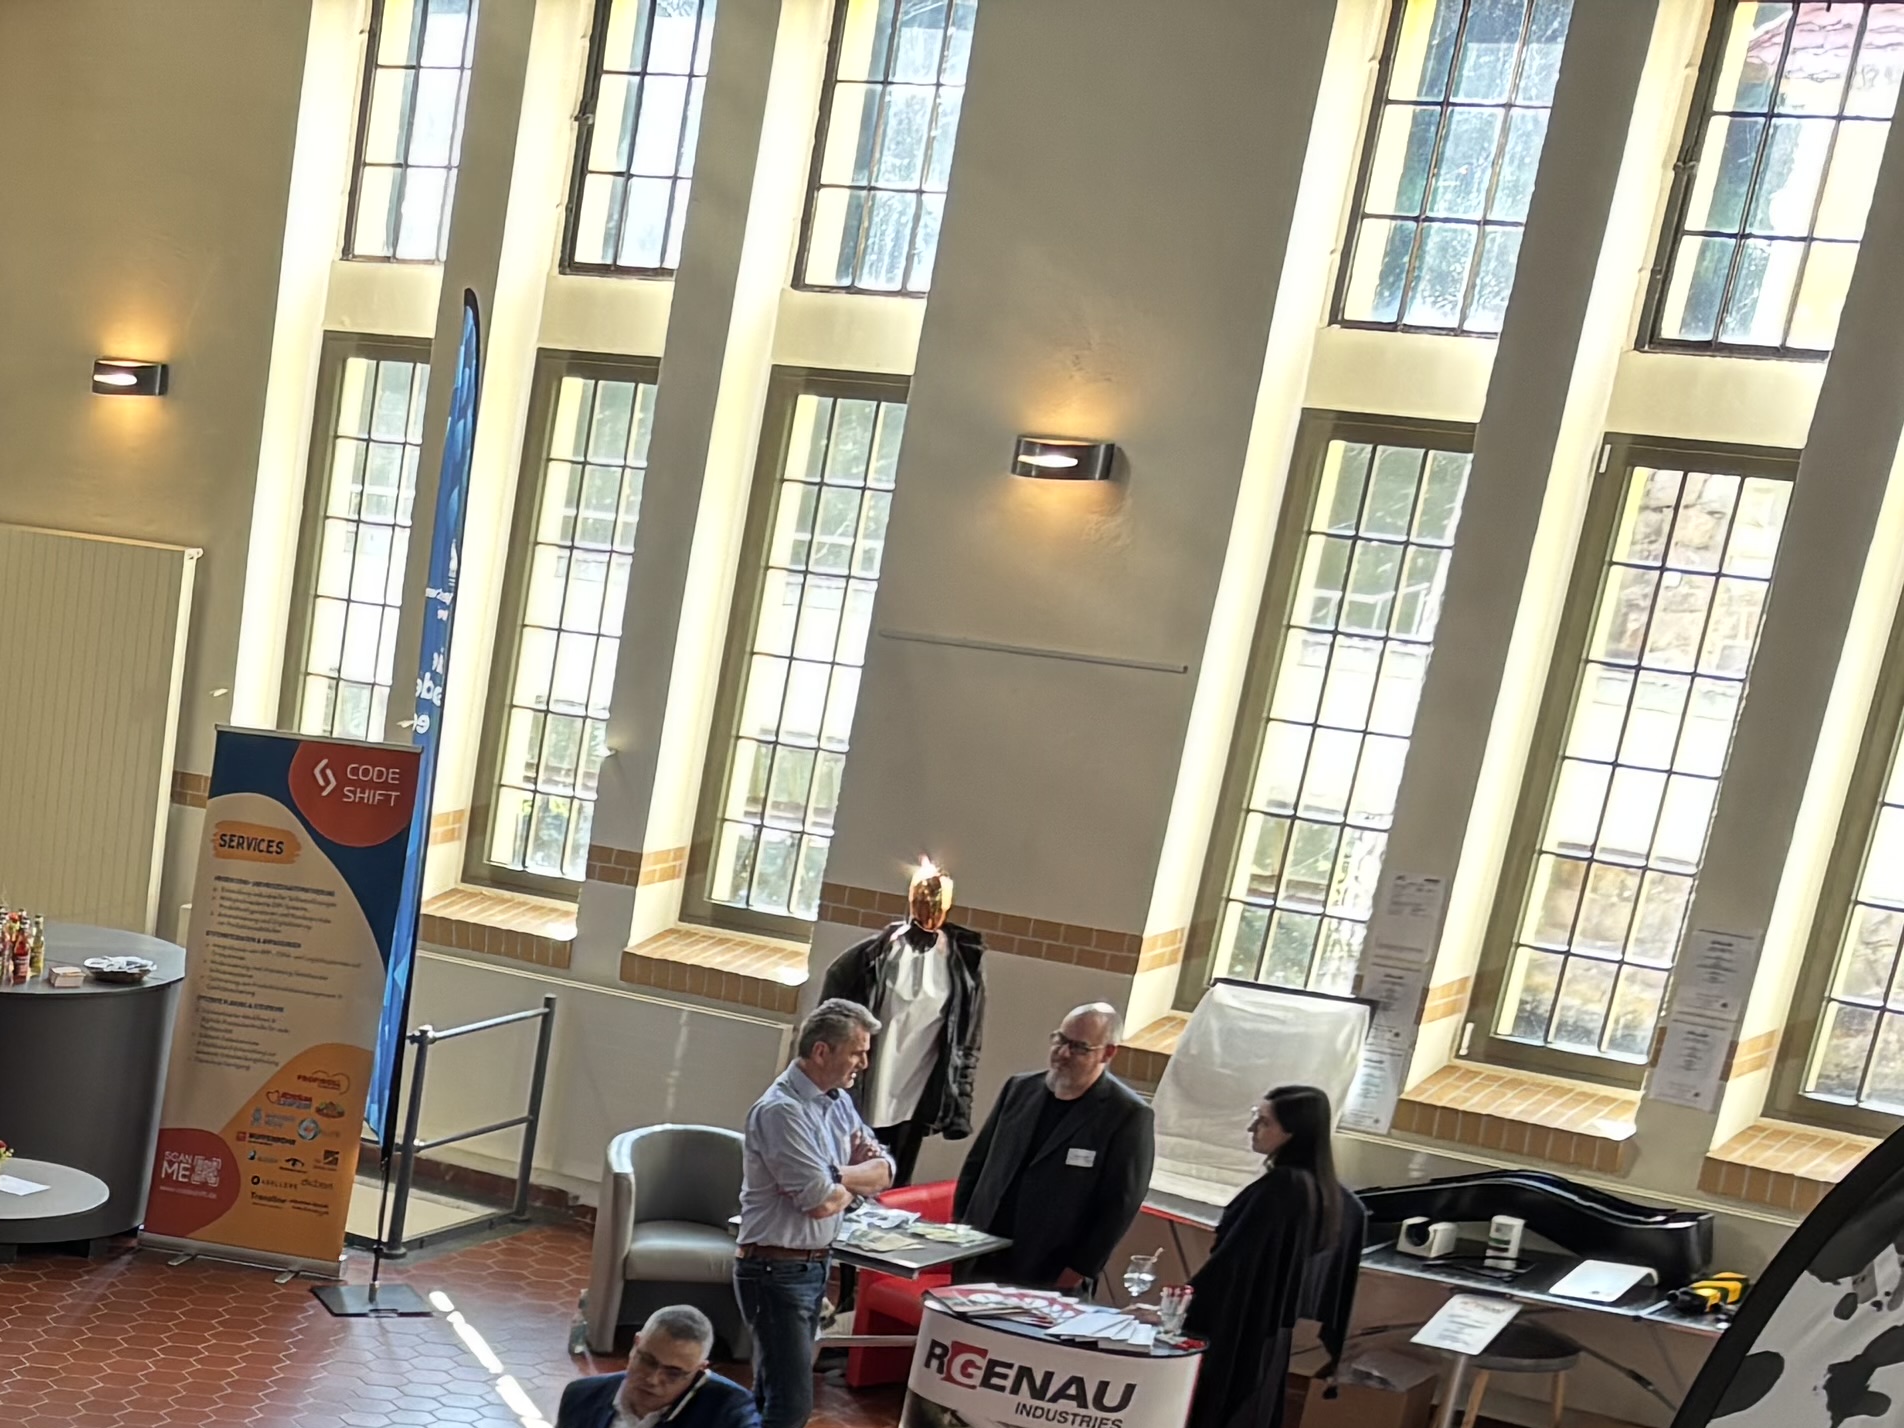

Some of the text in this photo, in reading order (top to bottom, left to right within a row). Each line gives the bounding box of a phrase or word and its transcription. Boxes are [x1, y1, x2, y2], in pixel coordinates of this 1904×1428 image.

[346, 763, 401, 784] CODE
[342, 786, 401, 807] SHIFT
[219, 833, 285, 855] SERVICES
[164, 1151, 192, 1162] SCAN
[161, 1161, 191, 1182] ME
